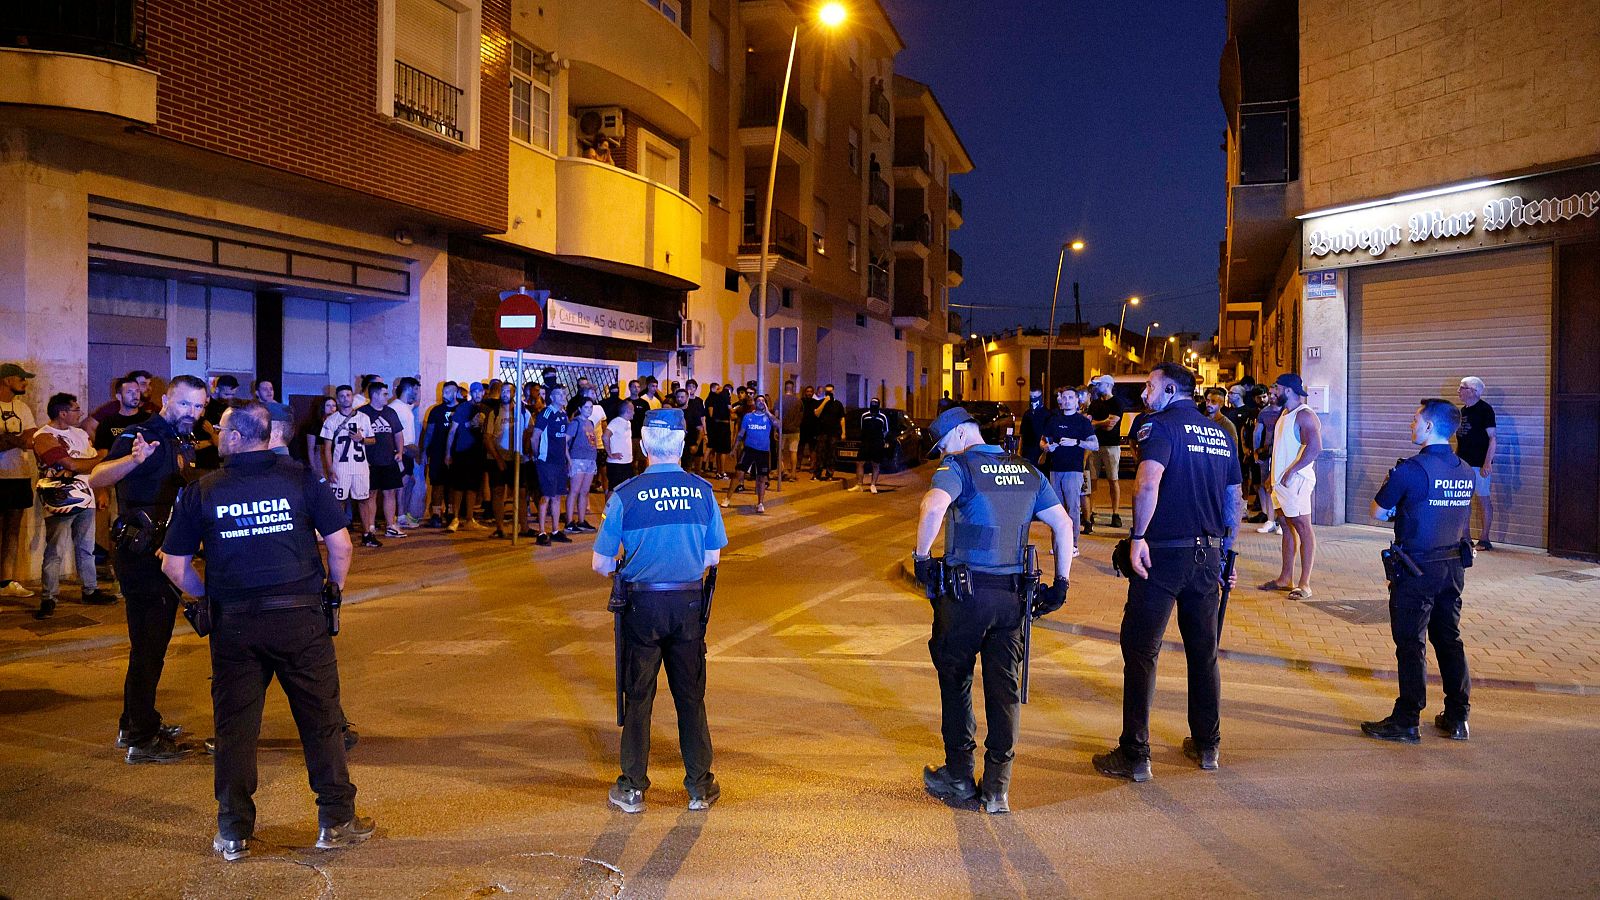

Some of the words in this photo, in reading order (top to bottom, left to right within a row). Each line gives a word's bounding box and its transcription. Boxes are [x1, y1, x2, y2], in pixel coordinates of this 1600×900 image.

[1310, 225, 1401, 256] Bodega
[1408, 209, 1476, 242] Mar
[1482, 190, 1600, 231] Menor
[594, 314, 605, 327] AS
[607, 316, 616, 329] de
[619, 318, 644, 333] COPAS
[1310, 348, 1319, 357] 17
[1184, 424, 1226, 439] POLICIA
[1206, 437, 1228, 447] LOCAL
[980, 464, 1030, 474] GUARDIA
[994, 475, 1025, 485] CIVIL
[1434, 480, 1473, 489] POLICIA
[637, 486, 703, 501] GUARDIA
[1454, 490, 1472, 498] LOCAL
[216, 498, 291, 518] POLICIA
[654, 499, 691, 511] CIVIL
[255, 511, 293, 525] LOCAL
[220, 528, 251, 539] TORRE
[251, 523, 294, 536] PACHECO
